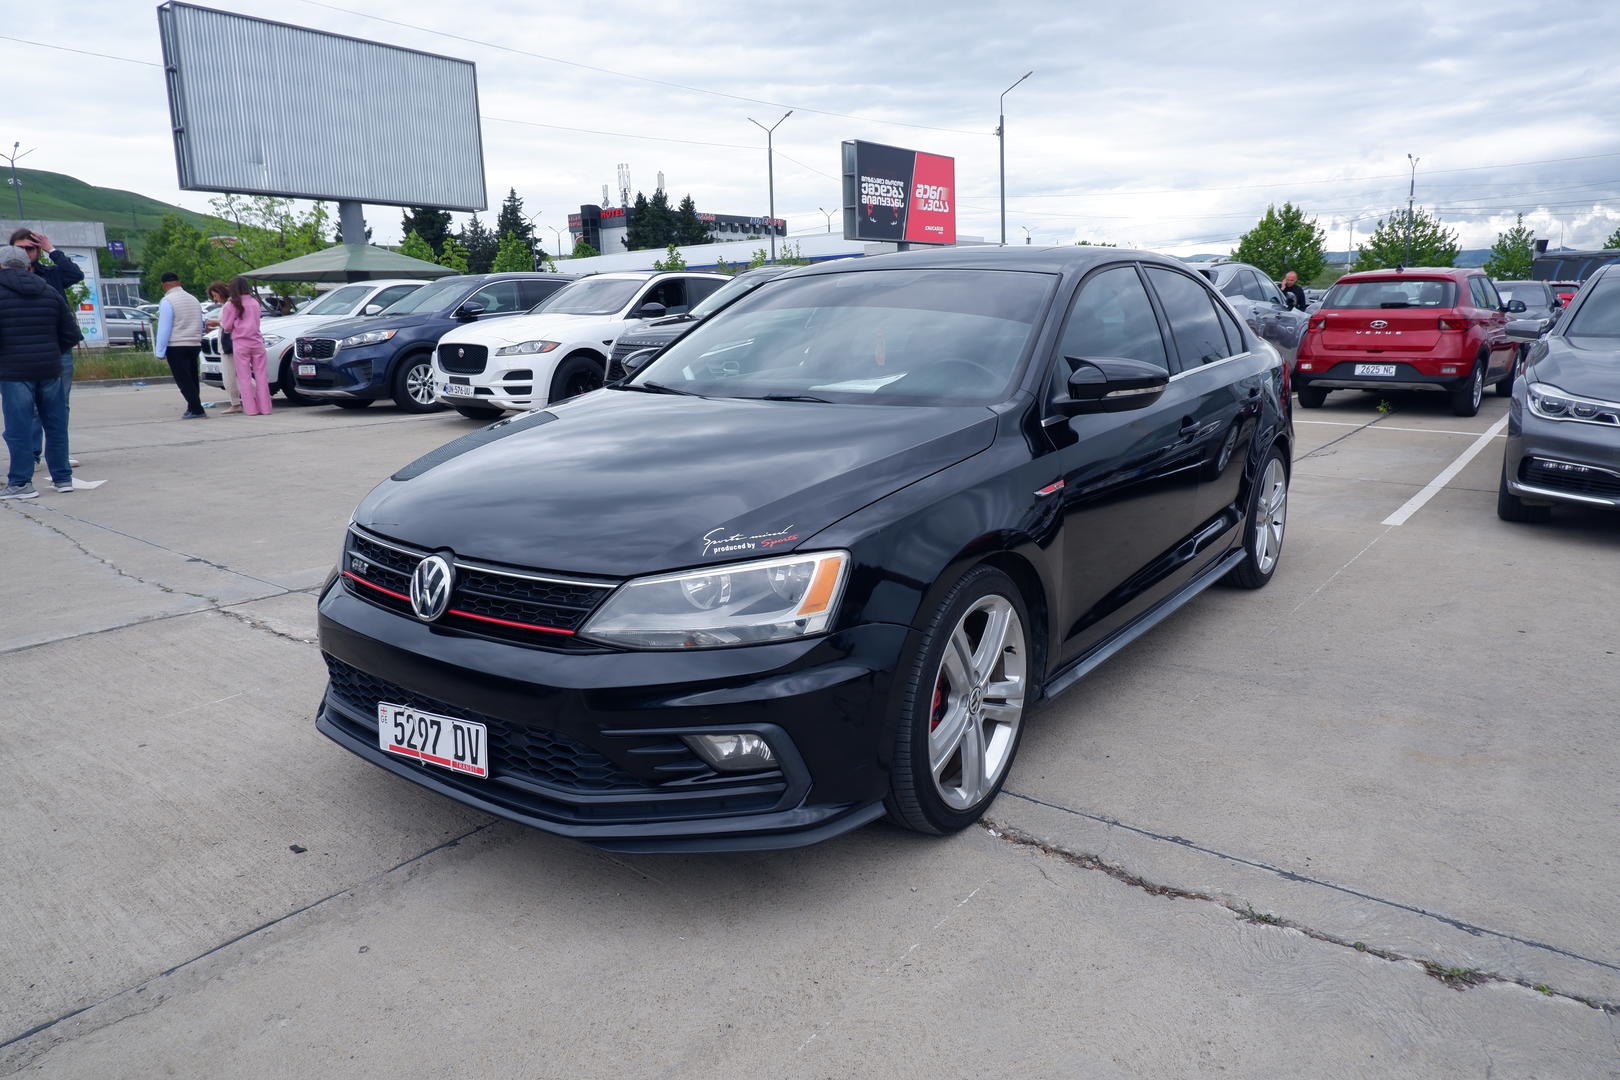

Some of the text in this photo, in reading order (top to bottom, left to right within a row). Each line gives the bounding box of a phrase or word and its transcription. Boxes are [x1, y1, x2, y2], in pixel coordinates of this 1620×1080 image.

[600, 208, 625, 219] HOTEL
[1361, 364, 1380, 375] 2625
[713, 544, 746, 555] produced
[393, 710, 479, 765] 5297 DV
